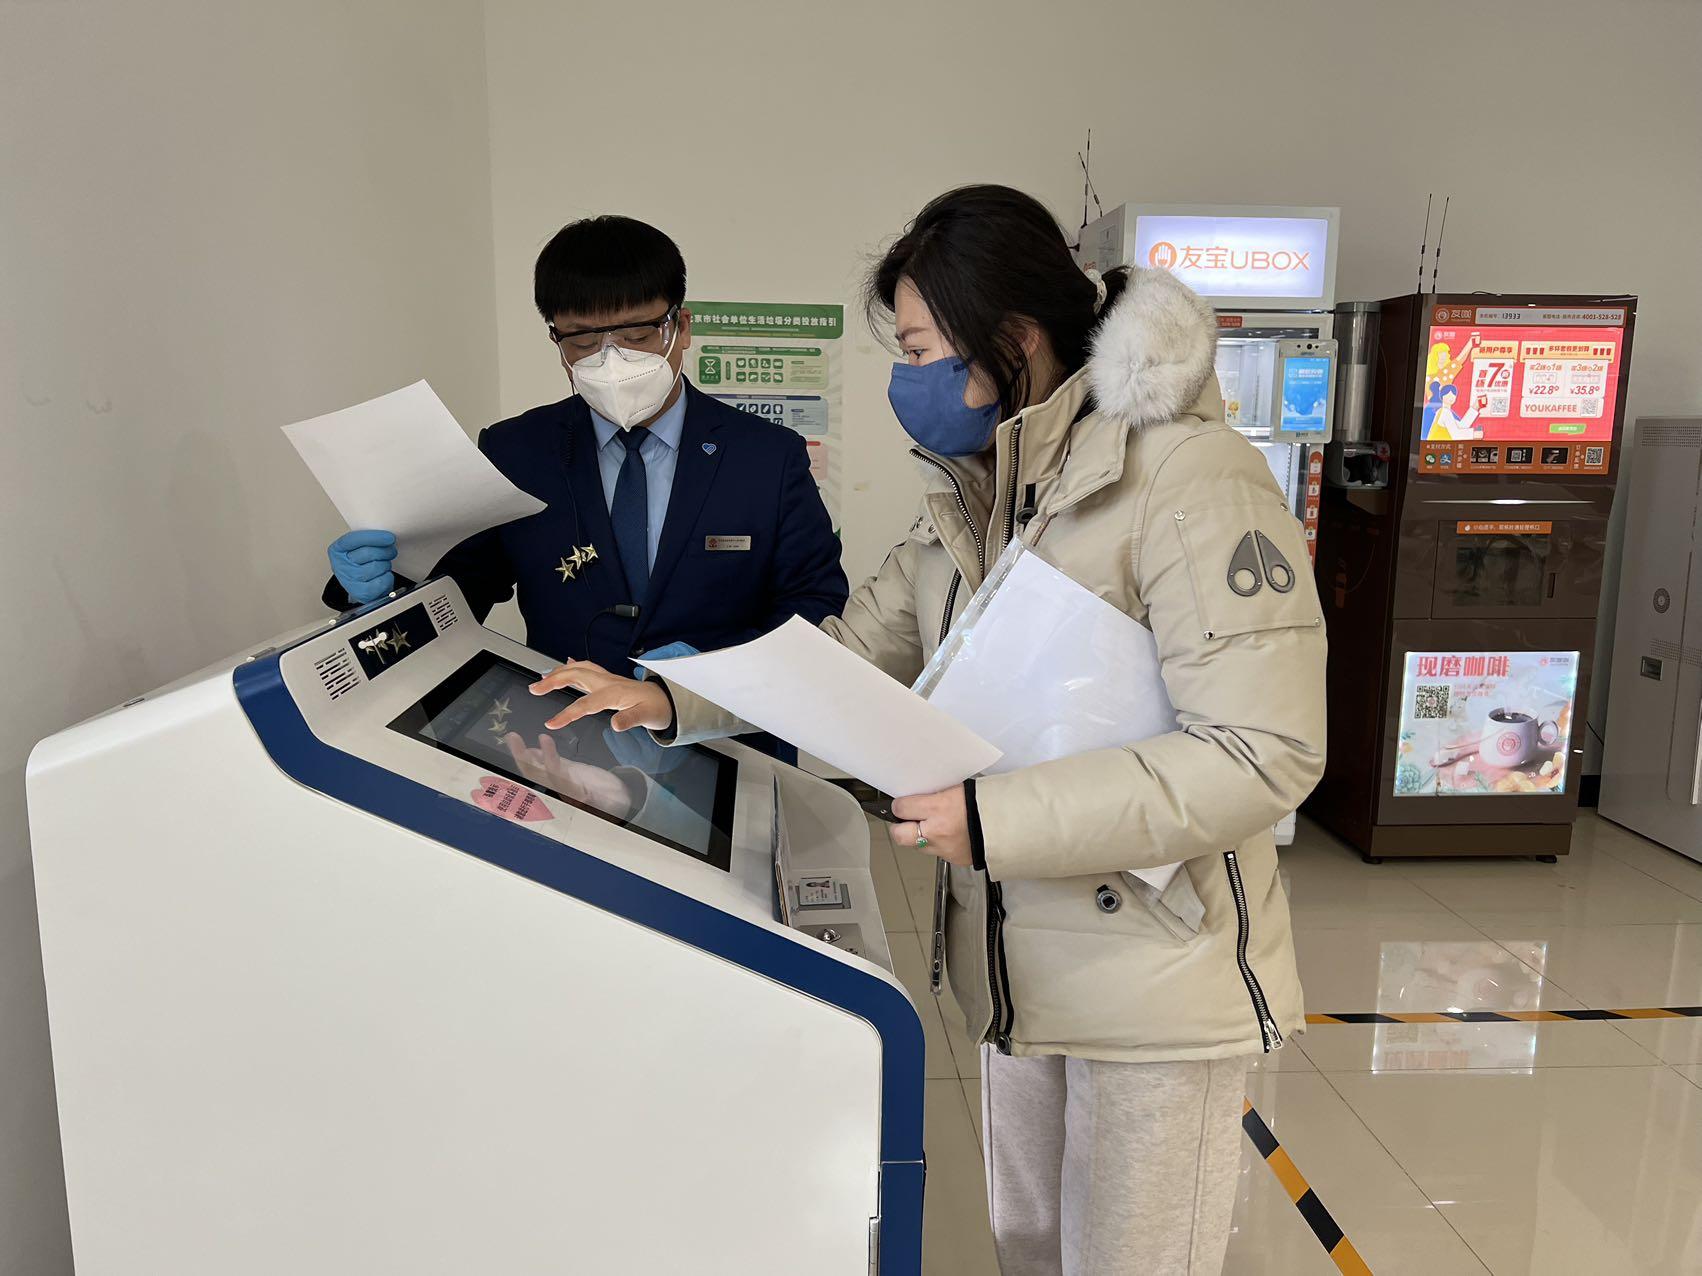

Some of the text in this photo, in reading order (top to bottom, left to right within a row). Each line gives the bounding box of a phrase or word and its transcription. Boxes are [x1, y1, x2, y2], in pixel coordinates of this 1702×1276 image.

[1179, 245, 1310, 271] 友宝UBOX
[1525, 404, 1577, 413] YOUKAFFEE
[1416, 655, 1511, 678] 现磨咖啡
